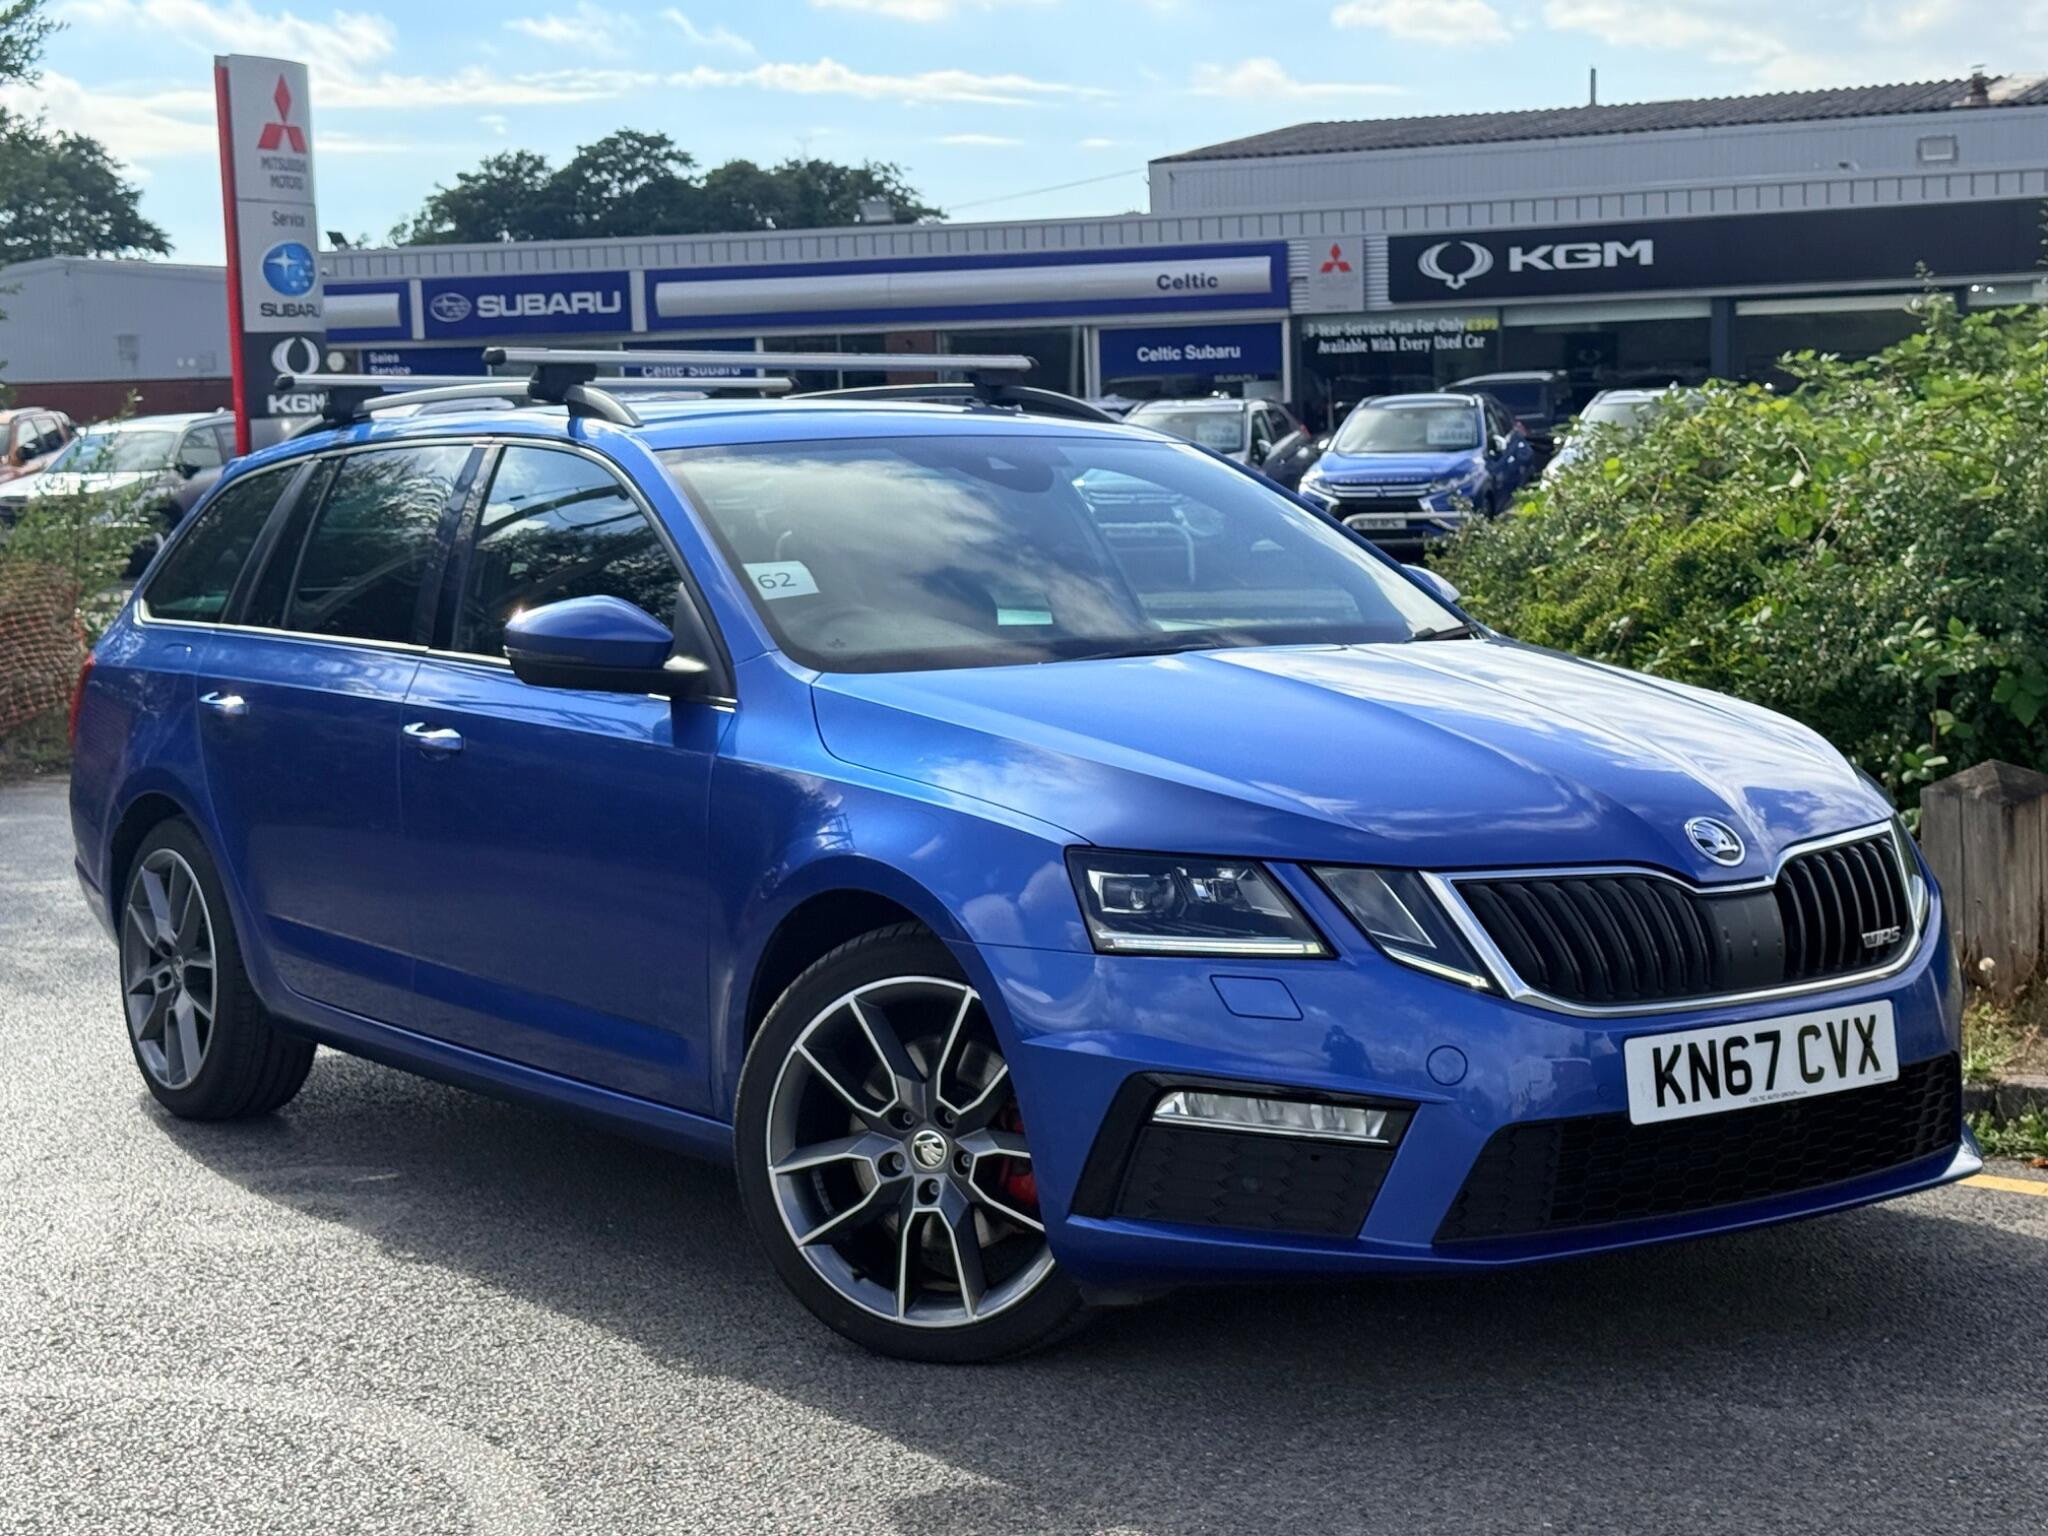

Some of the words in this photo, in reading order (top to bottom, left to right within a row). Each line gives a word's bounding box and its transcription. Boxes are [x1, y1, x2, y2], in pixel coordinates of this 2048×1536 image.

[1509, 239, 1654, 272] KGM
[1156, 274, 1219, 291] Celtic
[477, 291, 621, 318] SUBARU
[1136, 346, 1182, 362] Celtic
[1185, 344, 1241, 359] Subaru
[1317, 337, 1368, 354] Available
[1370, 336, 1397, 352] With
[1399, 335, 1431, 353] Every
[1434, 333, 1462, 350] Used
[1464, 333, 1486, 349] Car
[267, 393, 326, 414] KGM
[758, 572, 797, 589] 62
[1652, 1030, 1781, 1108] KN67
[1798, 1014, 1881, 1084] CVX
